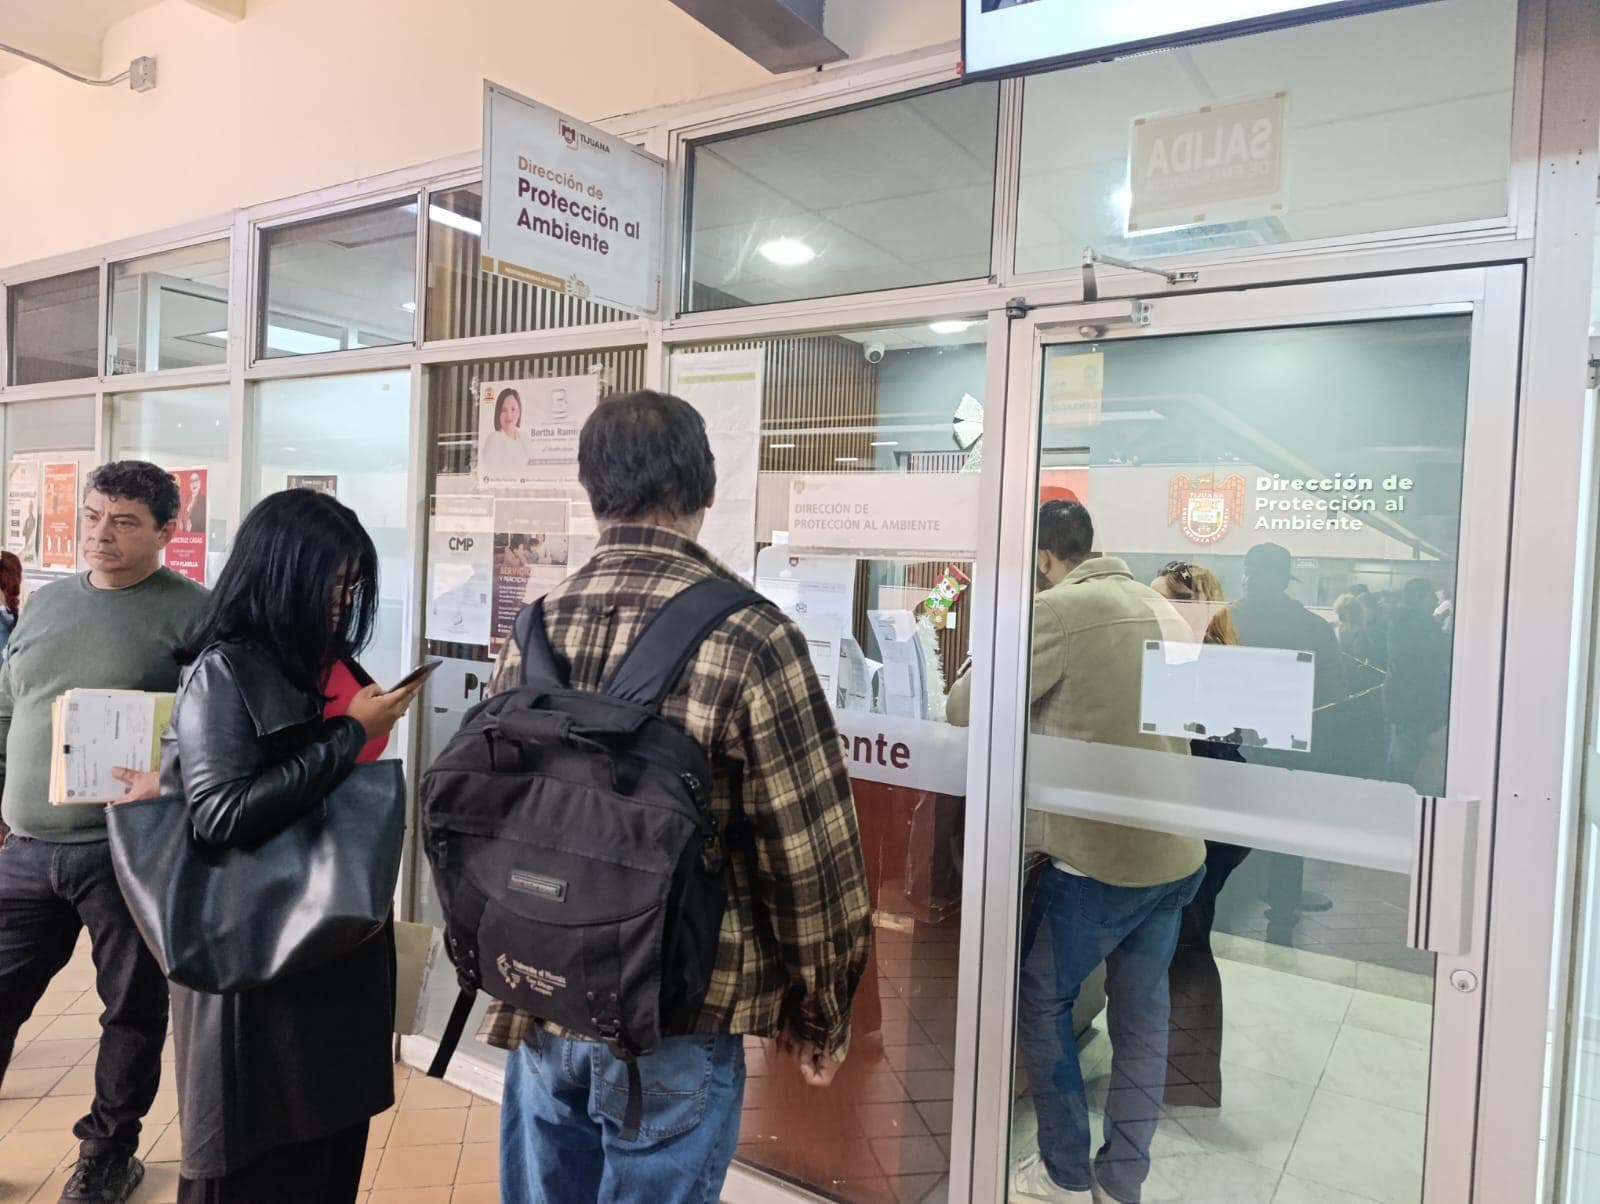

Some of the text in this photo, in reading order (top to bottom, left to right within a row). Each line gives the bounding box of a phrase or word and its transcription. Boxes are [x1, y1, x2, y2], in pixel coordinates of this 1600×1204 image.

[580, 132, 611, 153] TIJUANA
[518, 155, 604, 200] Dirección de
[518, 177, 640, 240] Protección al
[517, 207, 610, 256] Ambiente
[1255, 472, 1415, 492] Dirección de
[794, 502, 870, 515] DIRECCIÓN DE
[1255, 494, 1405, 513] Protección al
[794, 517, 942, 532] PROTECCIÓN AL AMBIENTE
[1254, 514, 1364, 532] Ambiente
[448, 536, 474, 552] CMP
